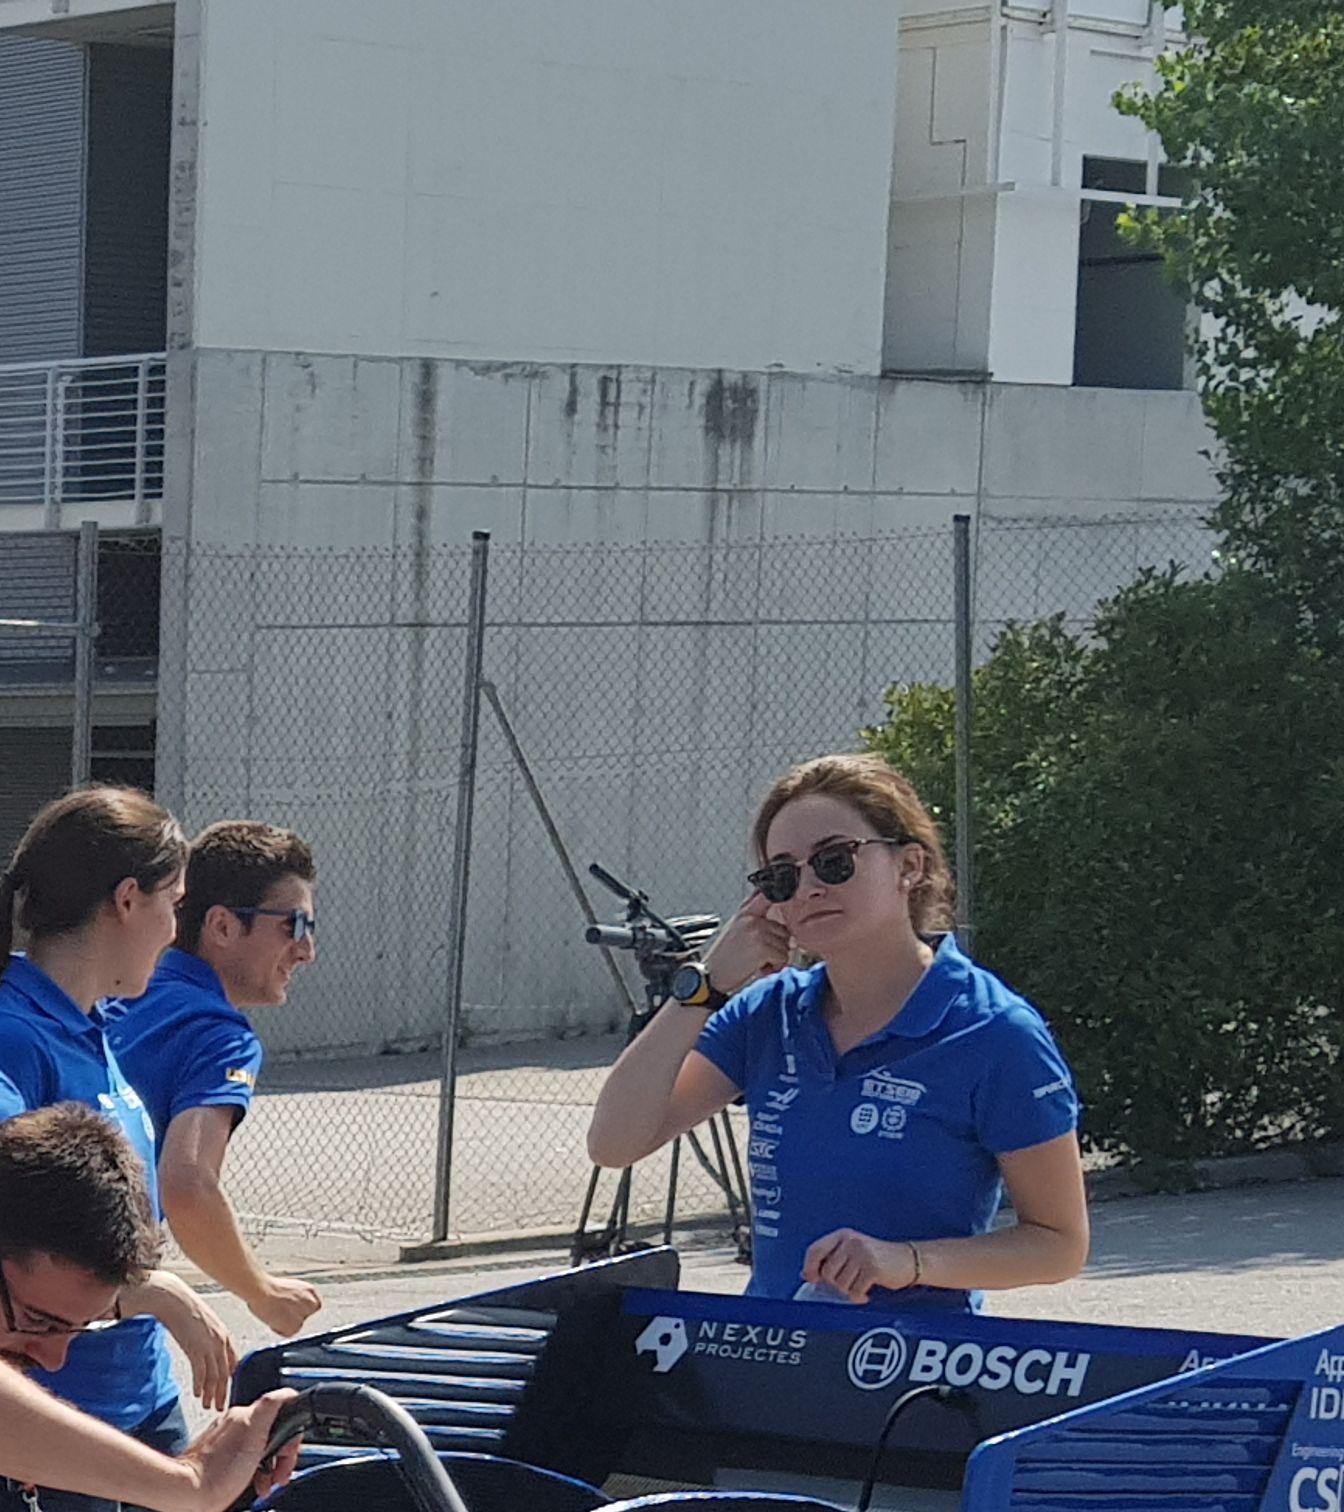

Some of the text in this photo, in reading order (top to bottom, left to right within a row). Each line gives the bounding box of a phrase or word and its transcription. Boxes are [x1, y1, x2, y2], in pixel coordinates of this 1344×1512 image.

[698, 1323, 808, 1349] NEXUS
[694, 1342, 803, 1366] PROJECTES
[910, 1340, 1091, 1397] BOSCH
